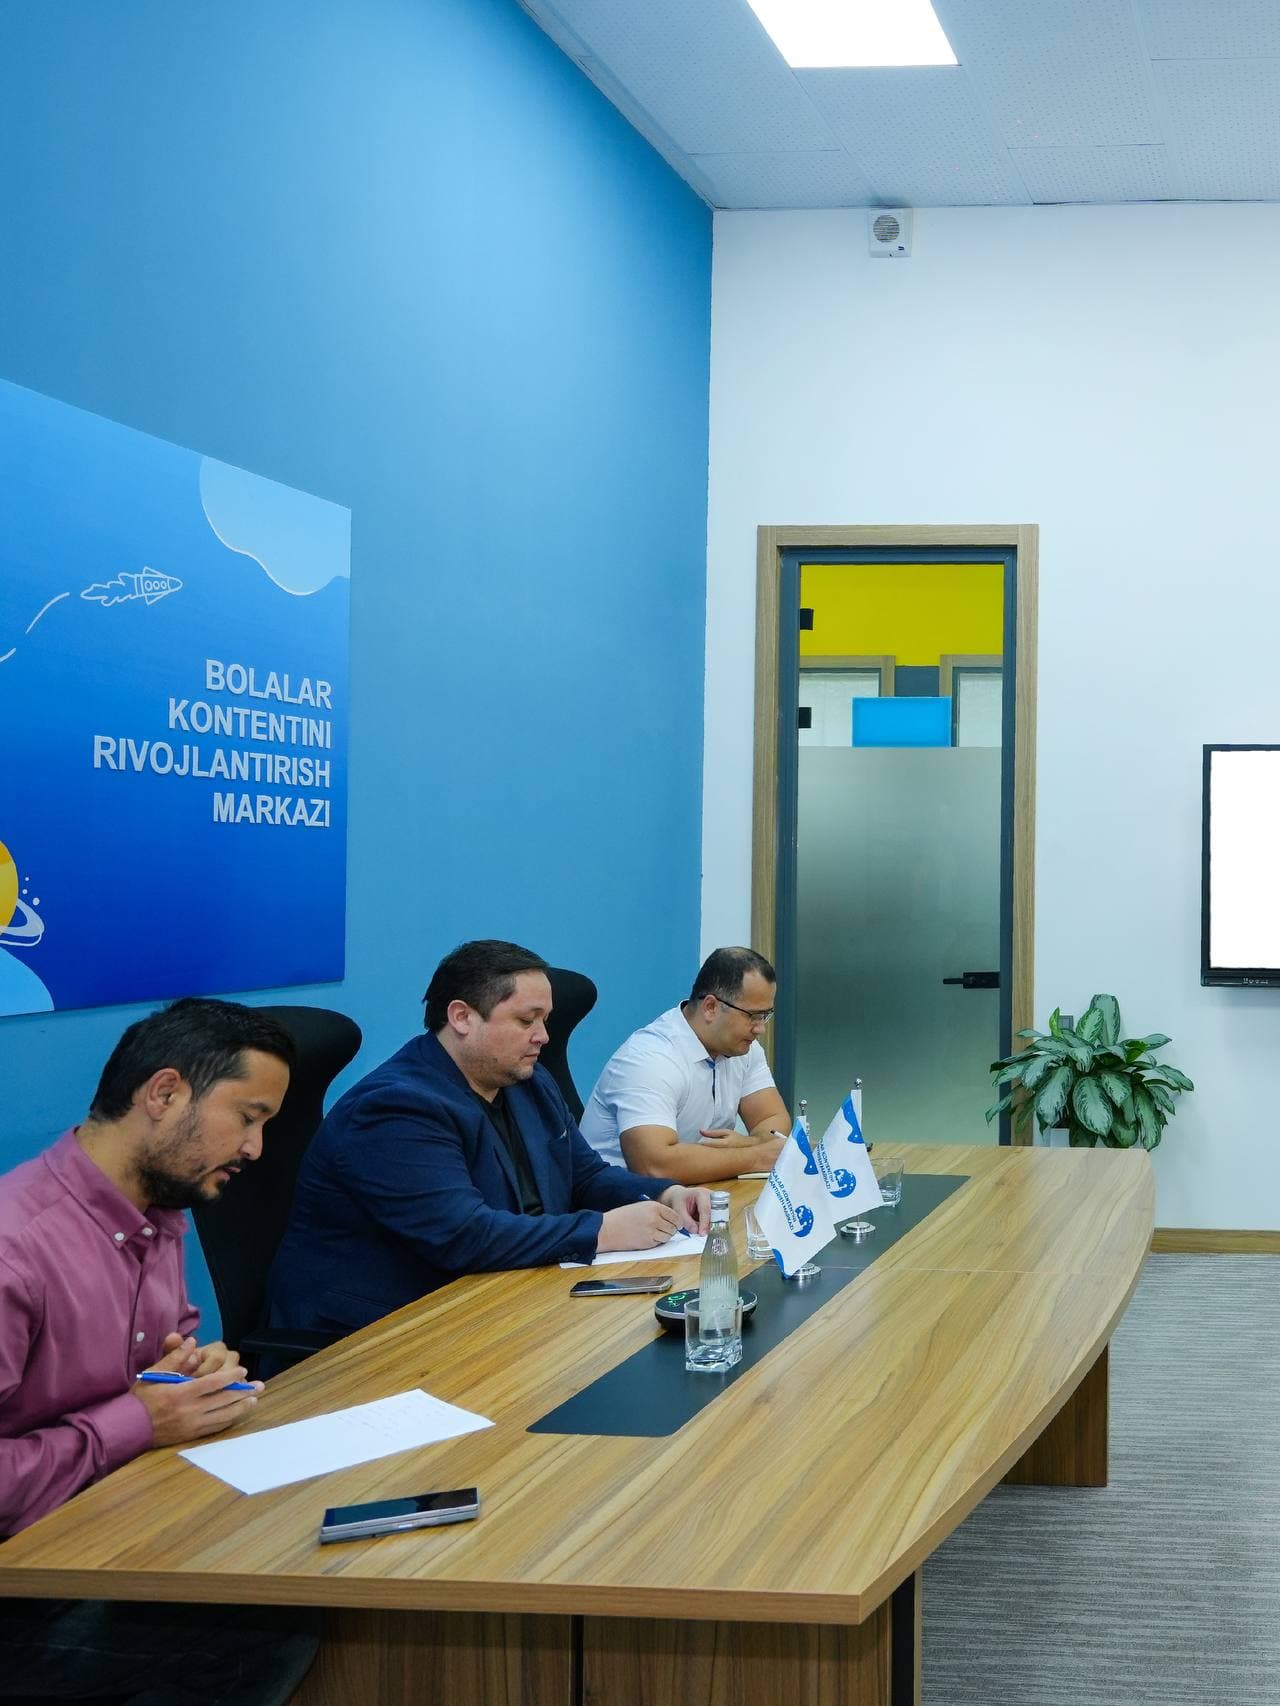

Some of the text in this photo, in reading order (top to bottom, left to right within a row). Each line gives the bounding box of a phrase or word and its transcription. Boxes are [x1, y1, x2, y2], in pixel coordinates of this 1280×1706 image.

[206, 659, 332, 709] BOLALAR
[168, 698, 332, 749] KONTENTINI
[93, 735, 331, 788] RIVOJLANTIRISH
[213, 792, 331, 828] MARKAZI
